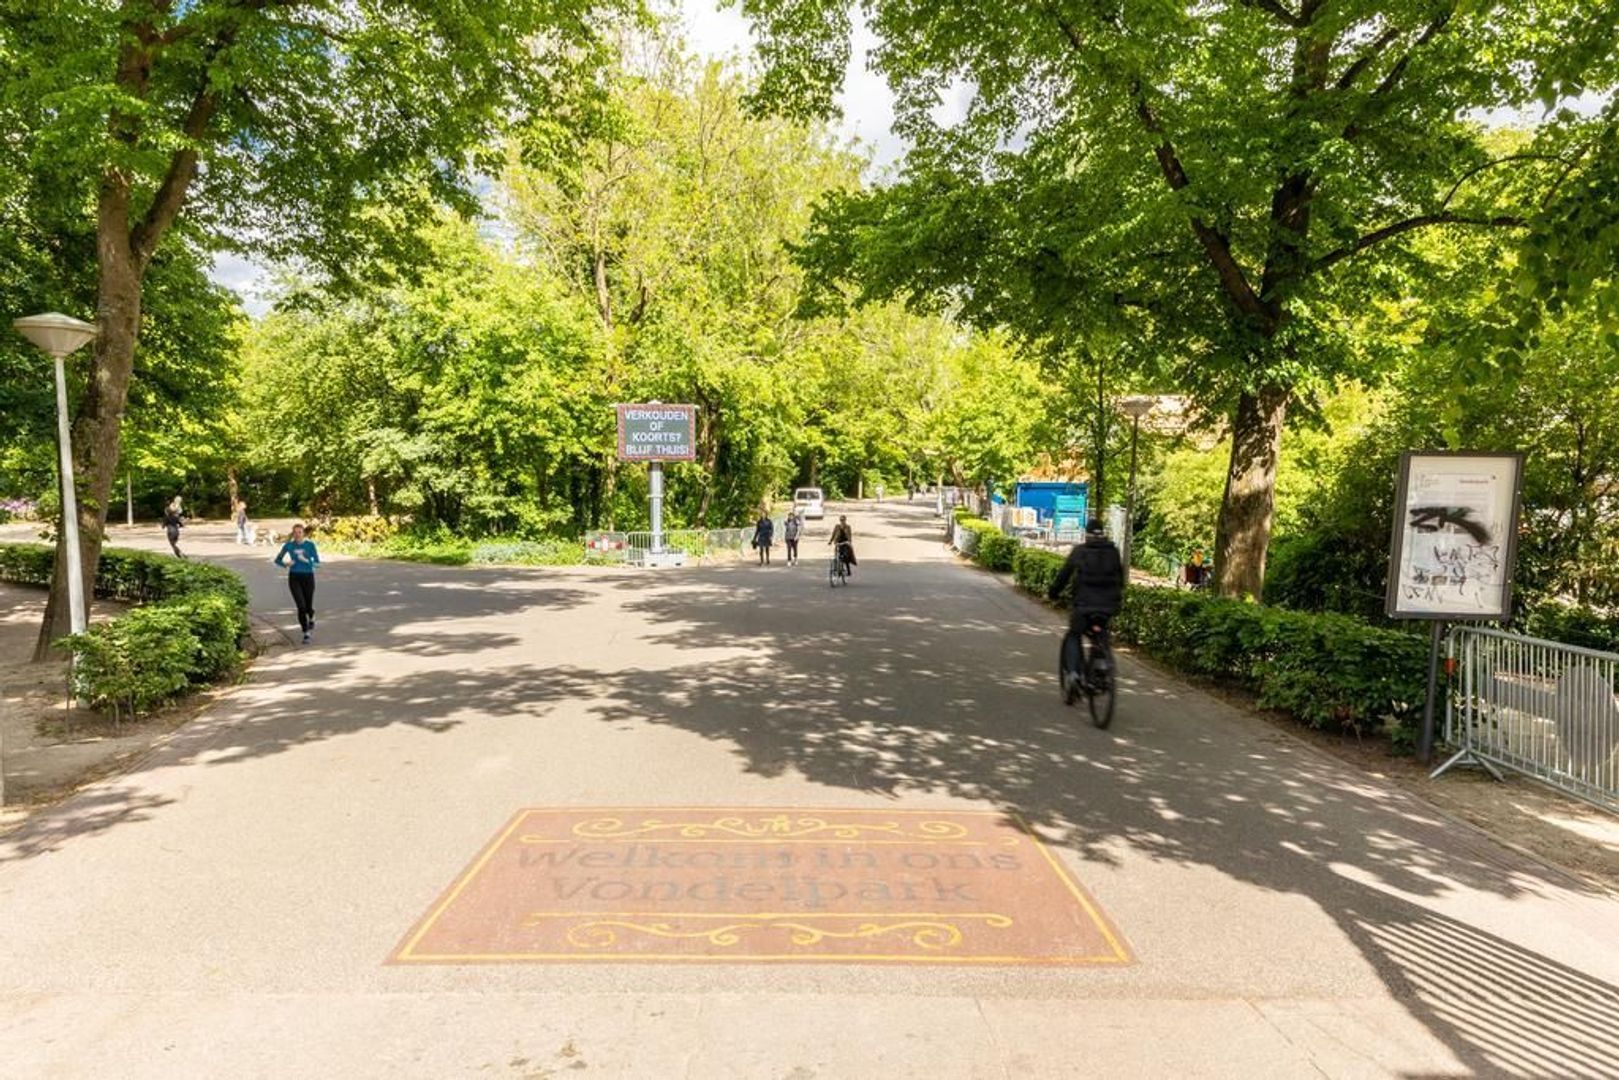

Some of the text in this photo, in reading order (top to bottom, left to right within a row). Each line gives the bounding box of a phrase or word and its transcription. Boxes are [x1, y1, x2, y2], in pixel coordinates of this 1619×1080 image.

[624, 410, 689, 420] VERKOUDEN
[649, 421, 664, 431] OF
[632, 432, 682, 442] KOORTS?
[626, 444, 653, 455] BLIJF
[815, 847, 879, 869] in
[900, 850, 1023, 871] ons
[550, 873, 980, 909] Vondelpark
